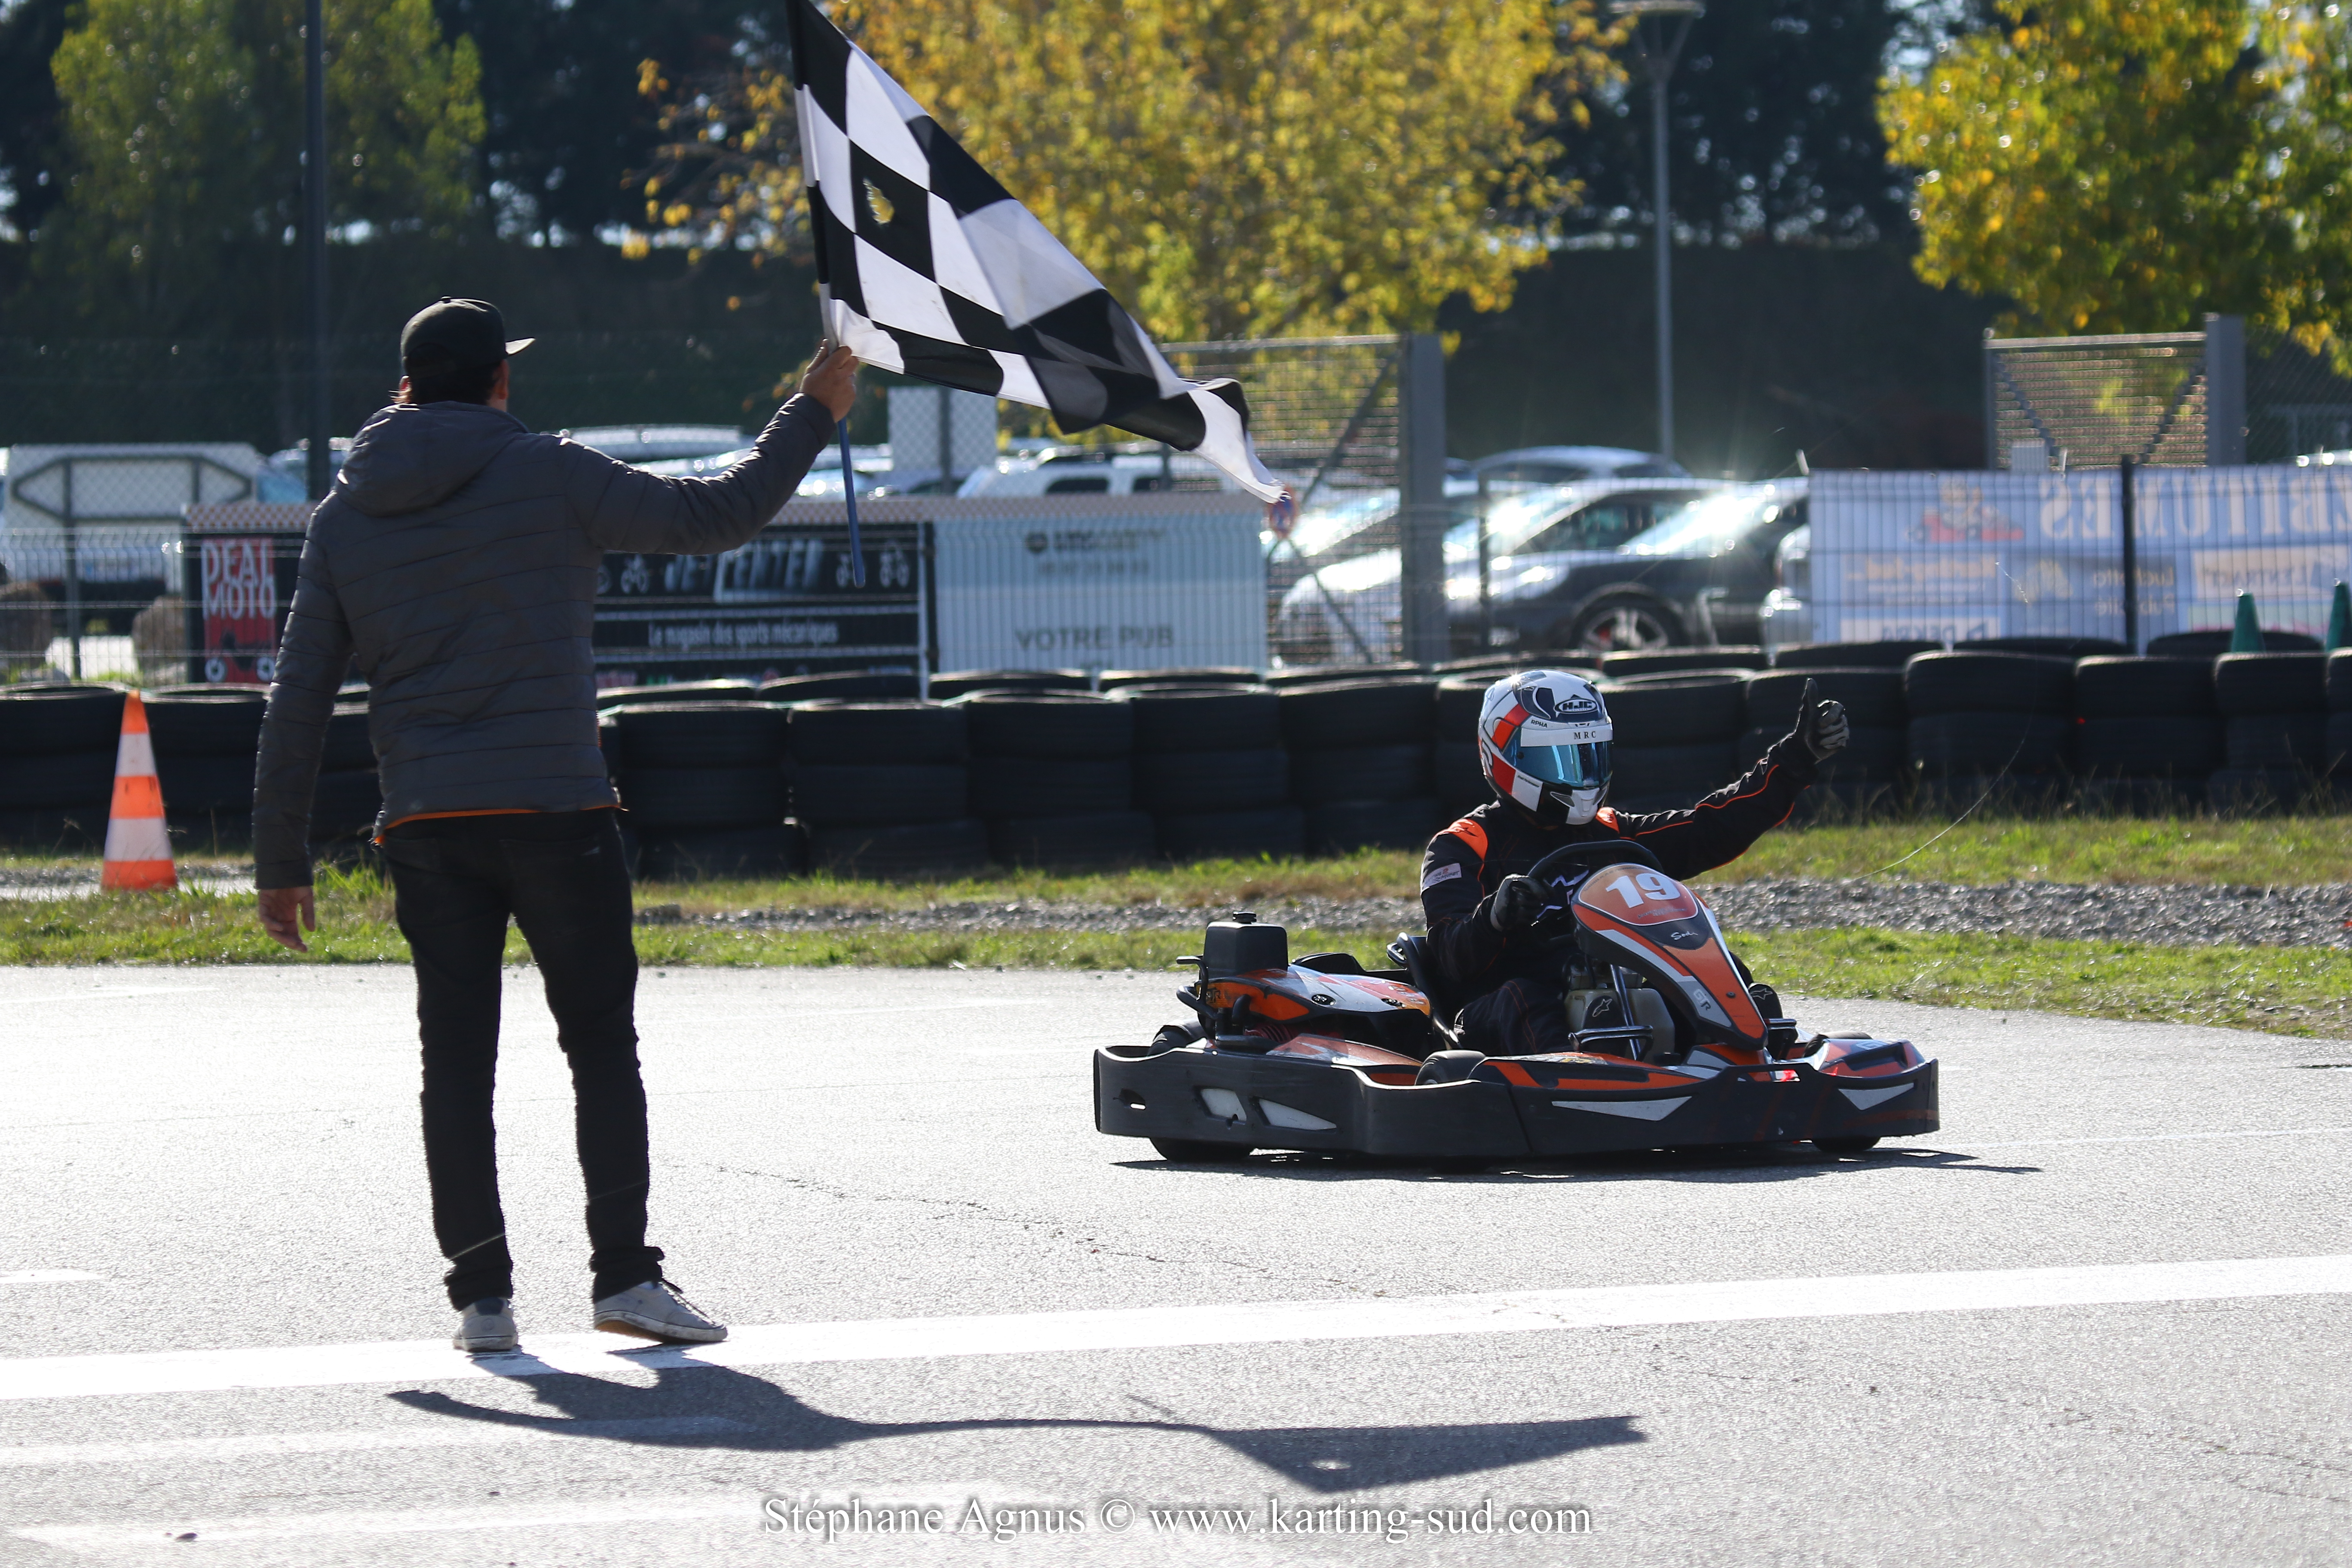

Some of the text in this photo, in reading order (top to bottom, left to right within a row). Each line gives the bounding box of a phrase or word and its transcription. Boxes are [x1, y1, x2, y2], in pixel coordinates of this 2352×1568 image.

[1015, 624, 1173, 651] VOTRE PUB
[1563, 701, 1592, 711] HJC
[1531, 719, 1548, 728] RPHA
[1605, 873, 1681, 908] 19
